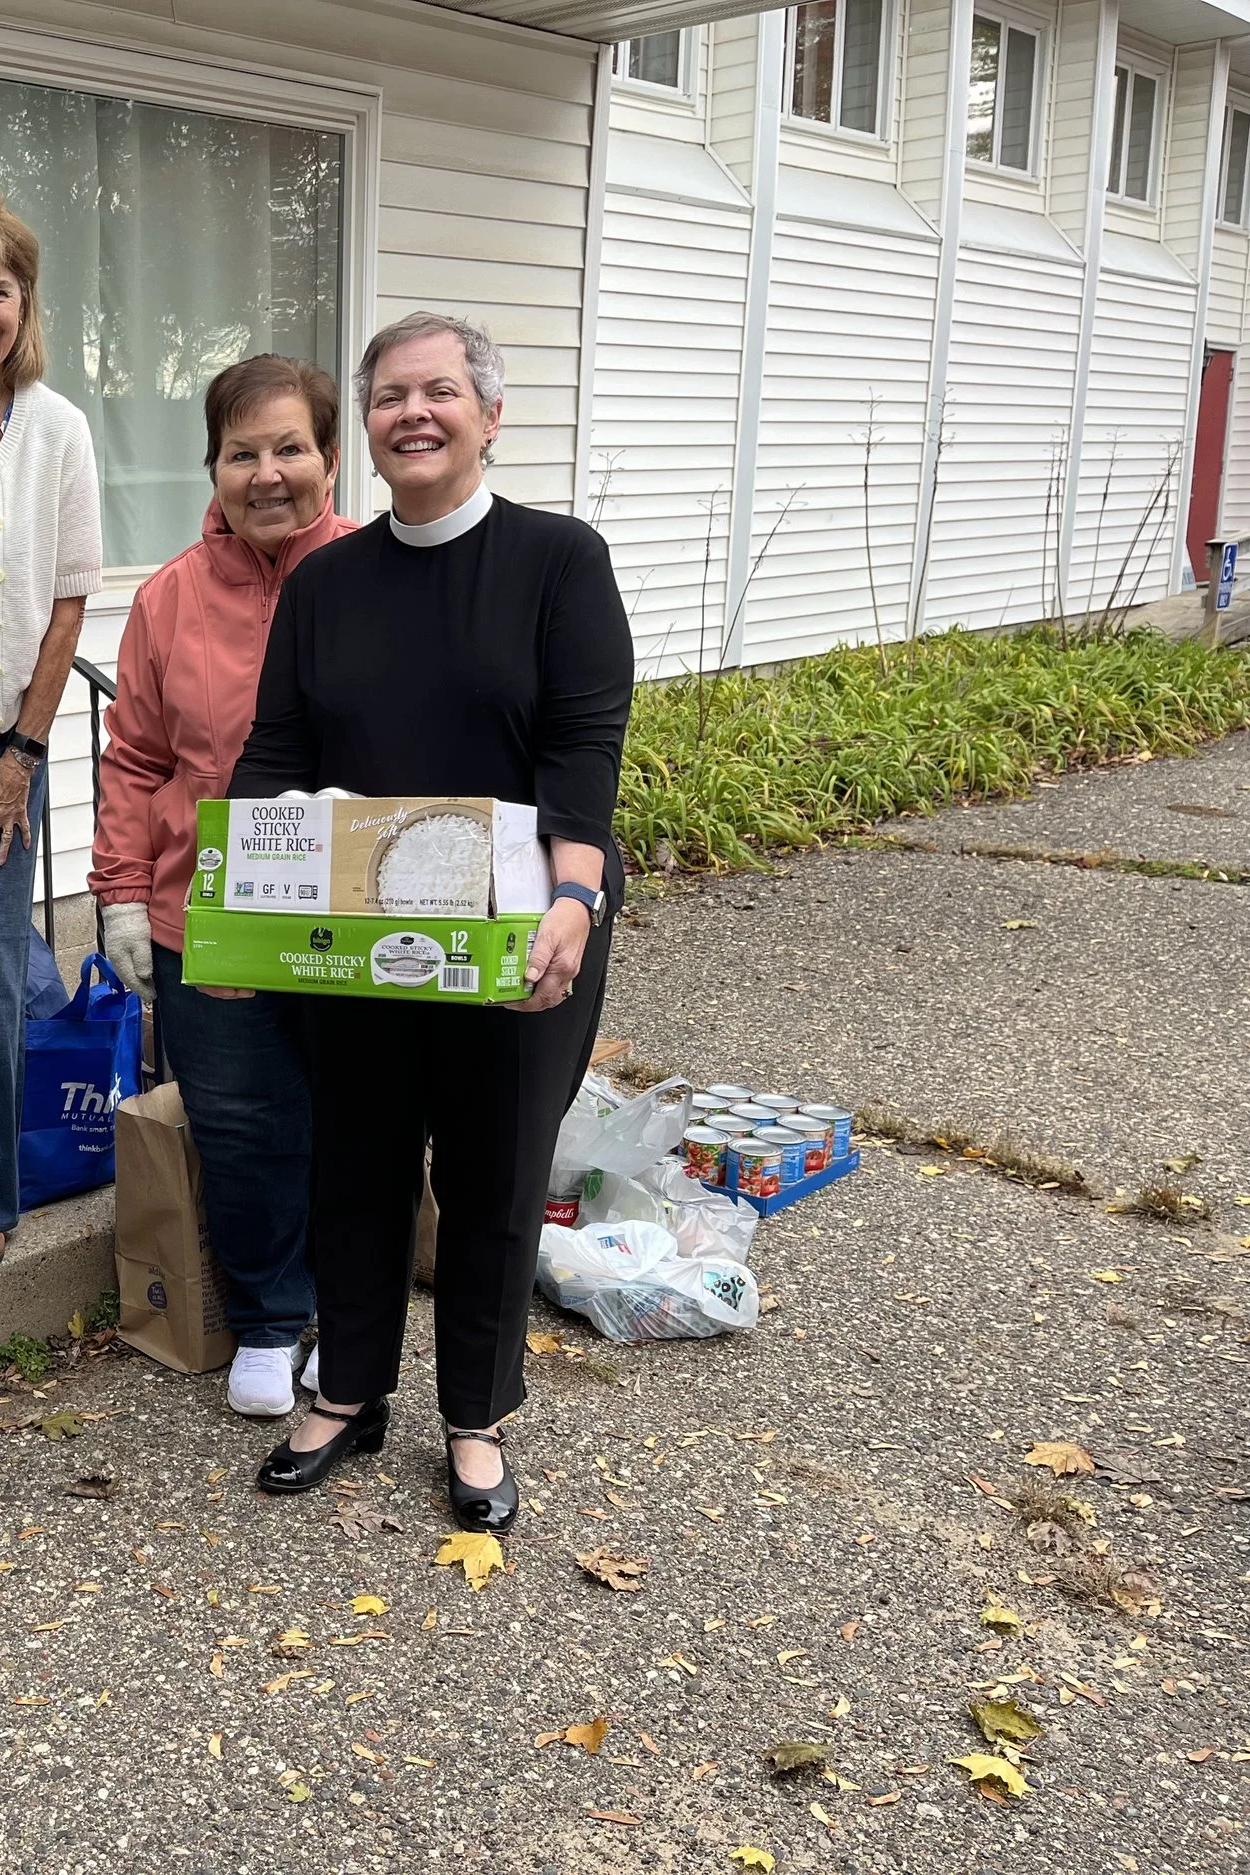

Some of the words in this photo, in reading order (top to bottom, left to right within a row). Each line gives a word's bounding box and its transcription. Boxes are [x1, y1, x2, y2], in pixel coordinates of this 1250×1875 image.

[252, 806, 305, 821] COOKED
[350, 807, 408, 832] Deliciously
[254, 822, 301, 836] STICKY
[377, 824, 398, 840] Soft
[241, 838, 282, 852] WHITE
[286, 838, 316, 852] RICE
[247, 853, 271, 861] MEDIUM
[272, 853, 292, 861] GRAIN
[293, 853, 306, 861] RICE
[203, 873, 215, 891] 12
[262, 883, 276, 895] GF
[283, 883, 291, 895] V
[450, 930, 468, 953] 12
[279, 952, 323, 965] COOKED
[326, 955, 366, 967] STICKY
[291, 965, 328, 978] WHITE
[330, 967, 355, 979] RICE
[71, 1123, 88, 1132] Bank
